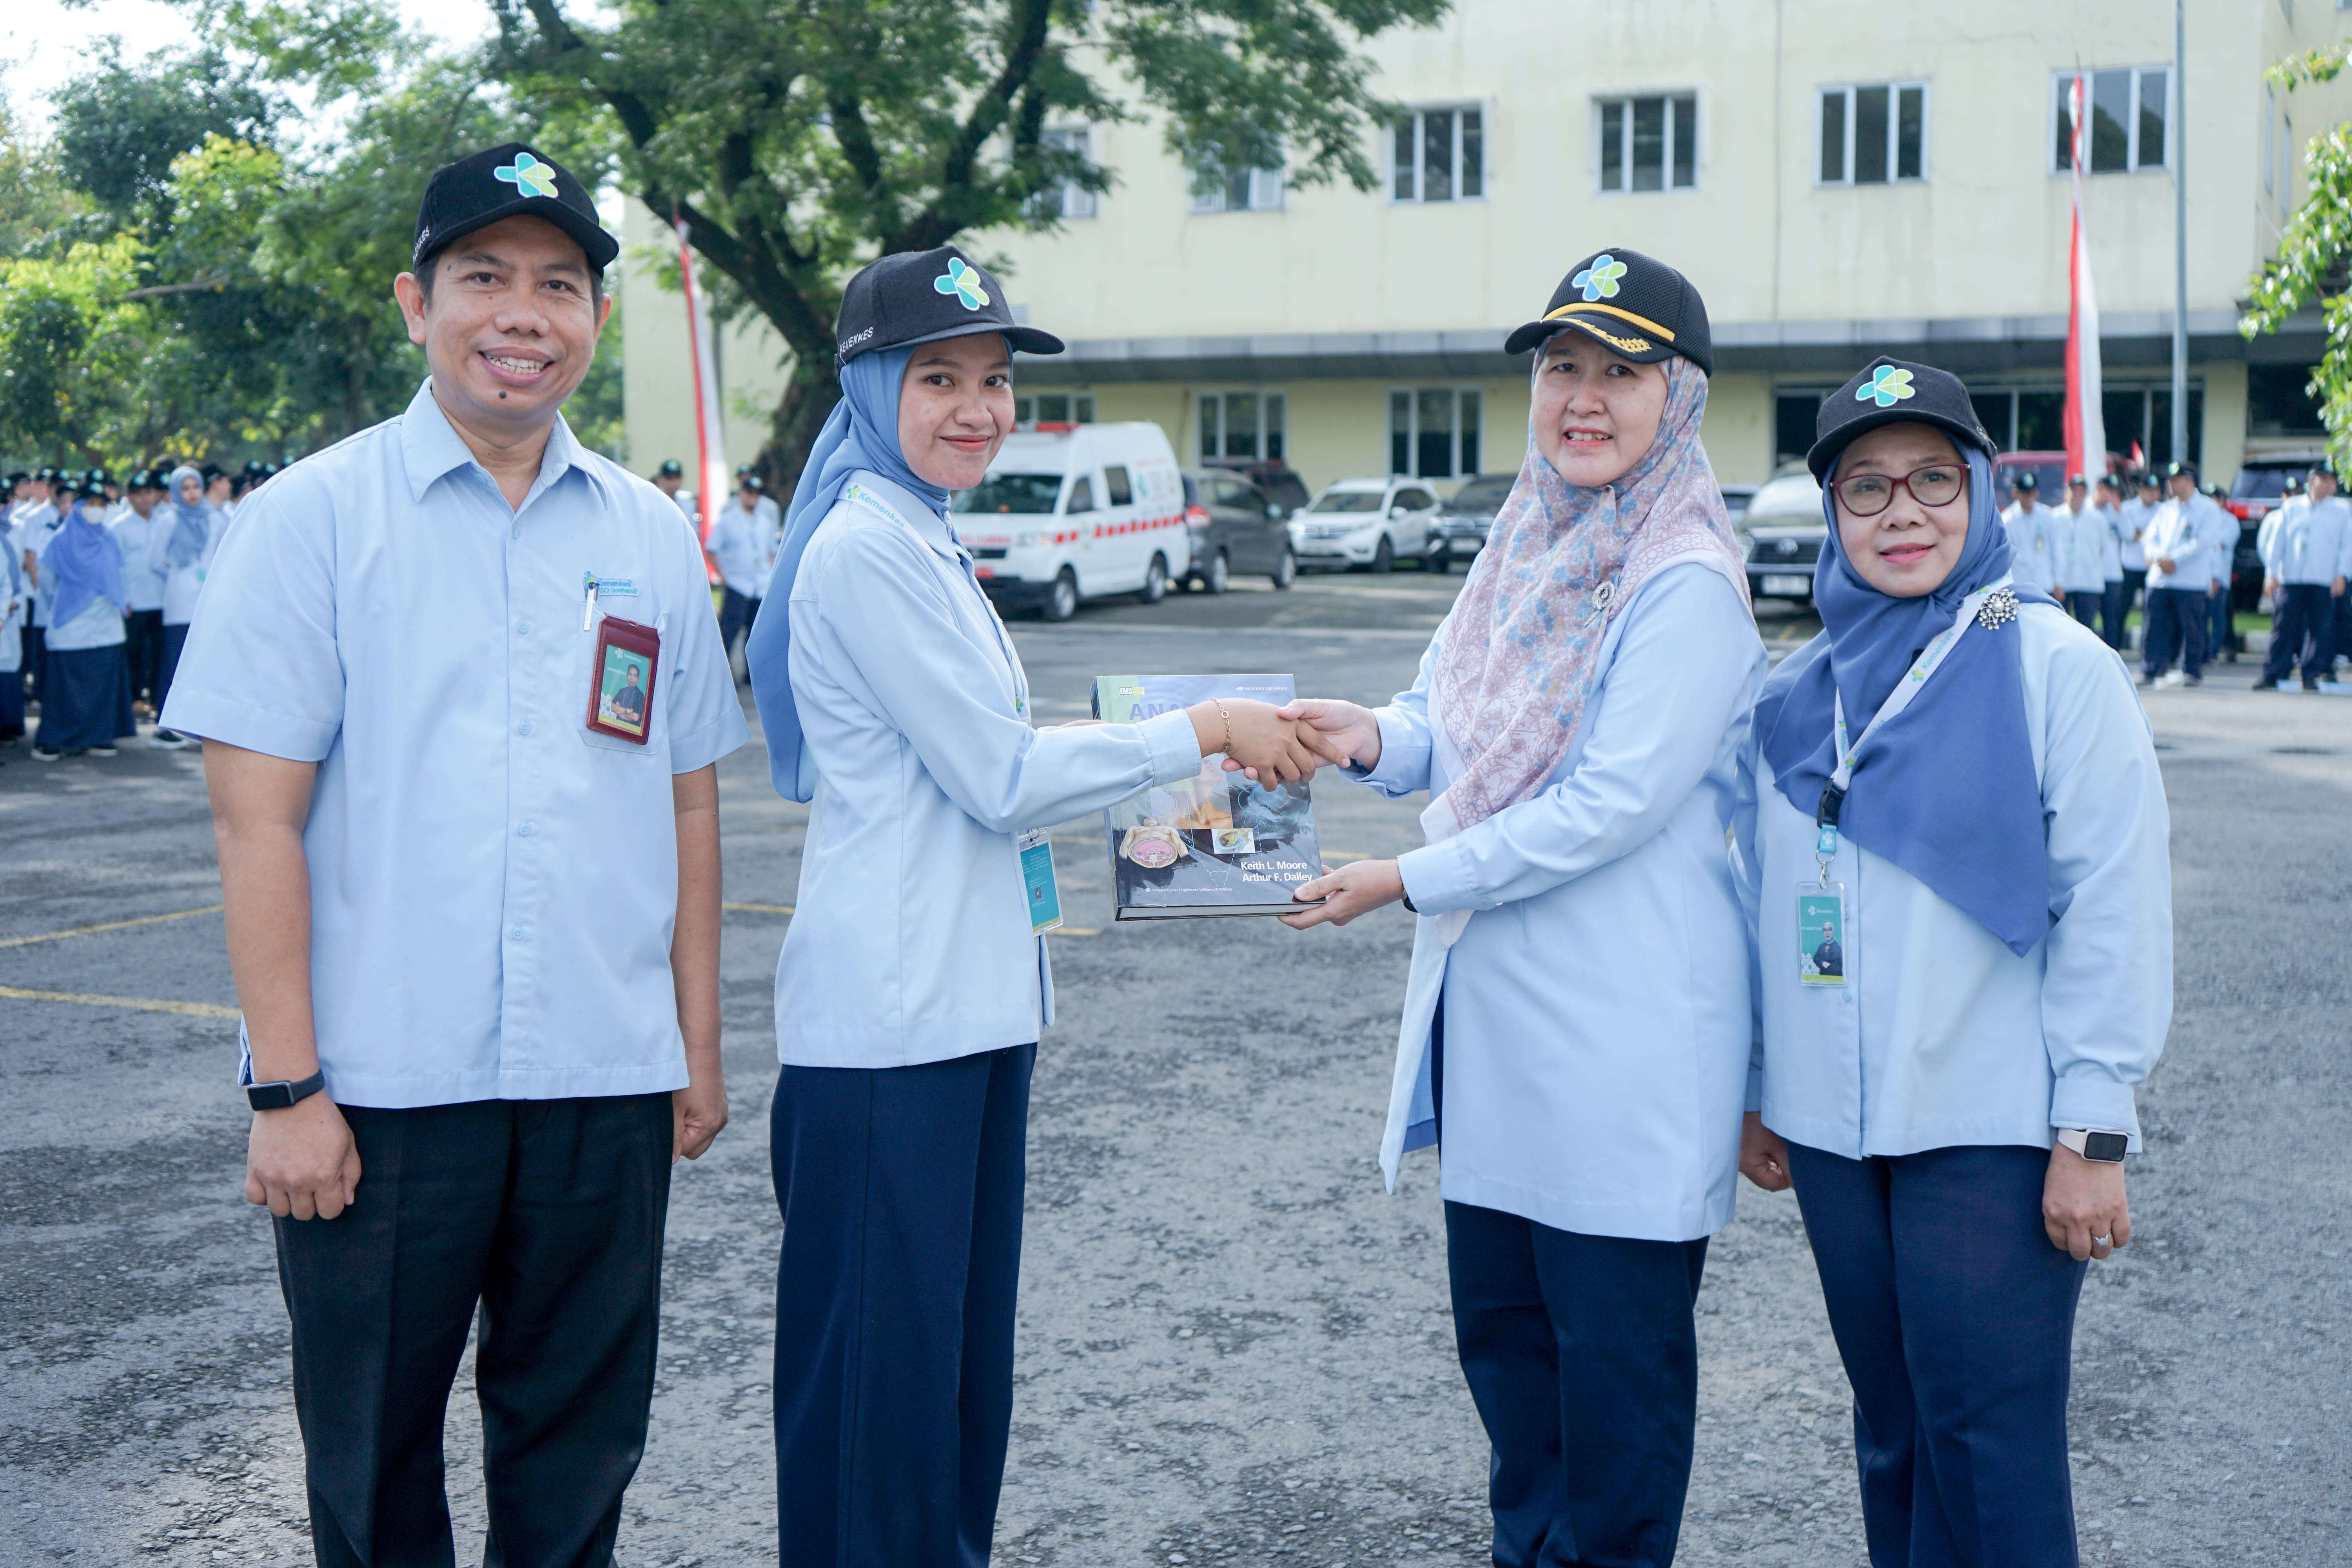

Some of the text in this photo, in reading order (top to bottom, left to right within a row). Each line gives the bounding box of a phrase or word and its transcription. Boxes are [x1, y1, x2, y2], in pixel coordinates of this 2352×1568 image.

[858, 491, 905, 528] Kemenkes
[1921, 632, 1954, 670] Kemenkes
[1241, 861, 1307, 870] Keith L. Moore
[1242, 872, 1313, 882] Arthur F. Dalley
